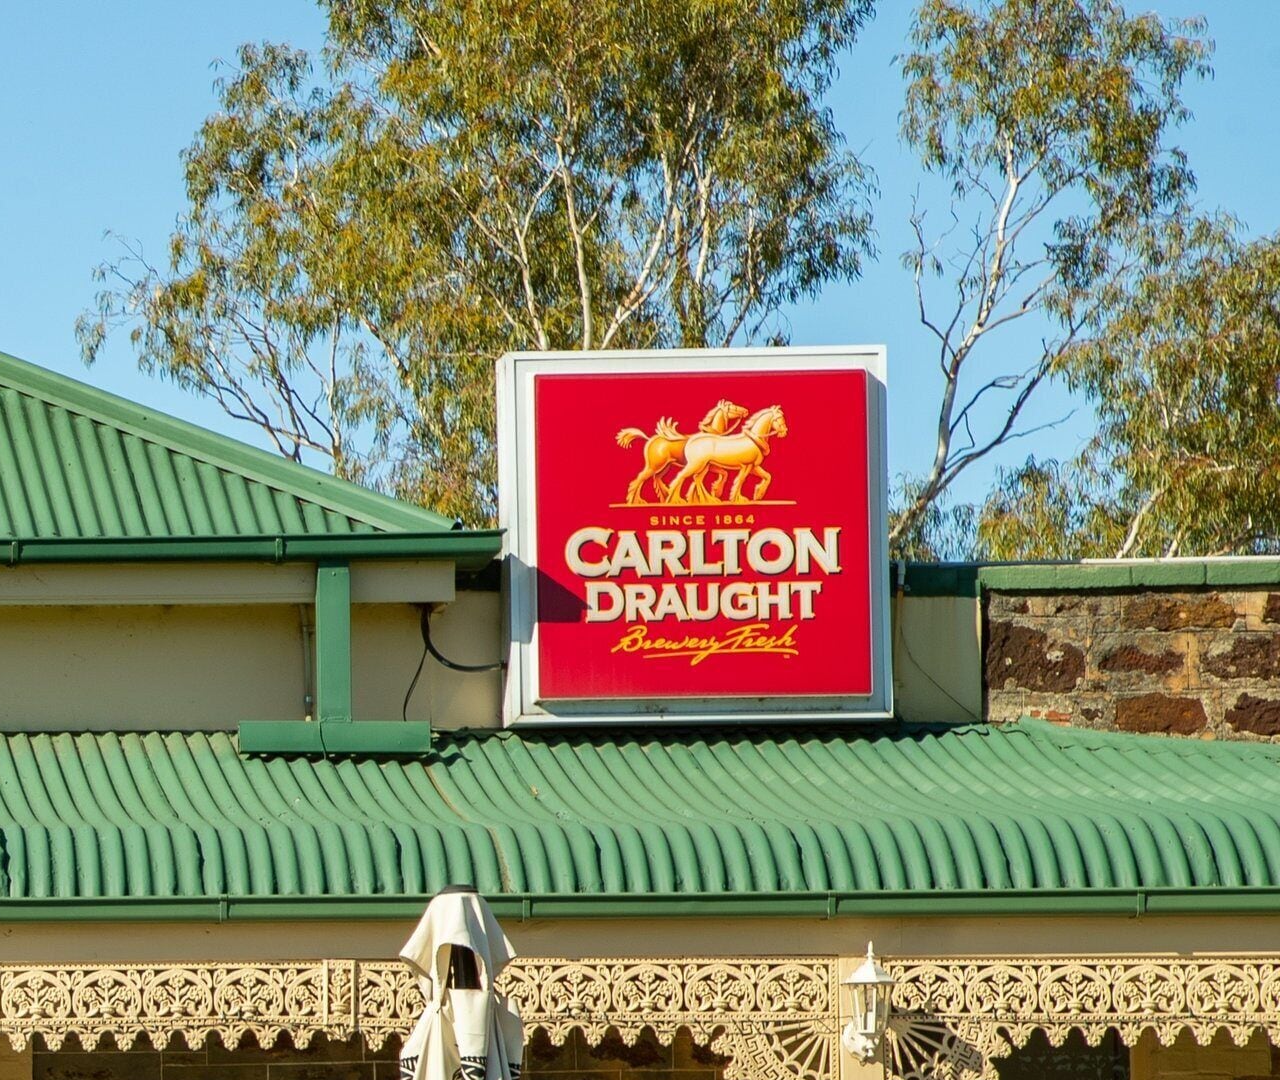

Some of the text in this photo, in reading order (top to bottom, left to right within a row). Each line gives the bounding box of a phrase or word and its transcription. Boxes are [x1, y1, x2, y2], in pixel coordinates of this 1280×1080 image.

[649, 514, 756, 526] SINCE 1864
[564, 526, 842, 578] CARLTON
[584, 580, 823, 623] DRAUGHT
[610, 623, 799, 666] Brewery Fresh
